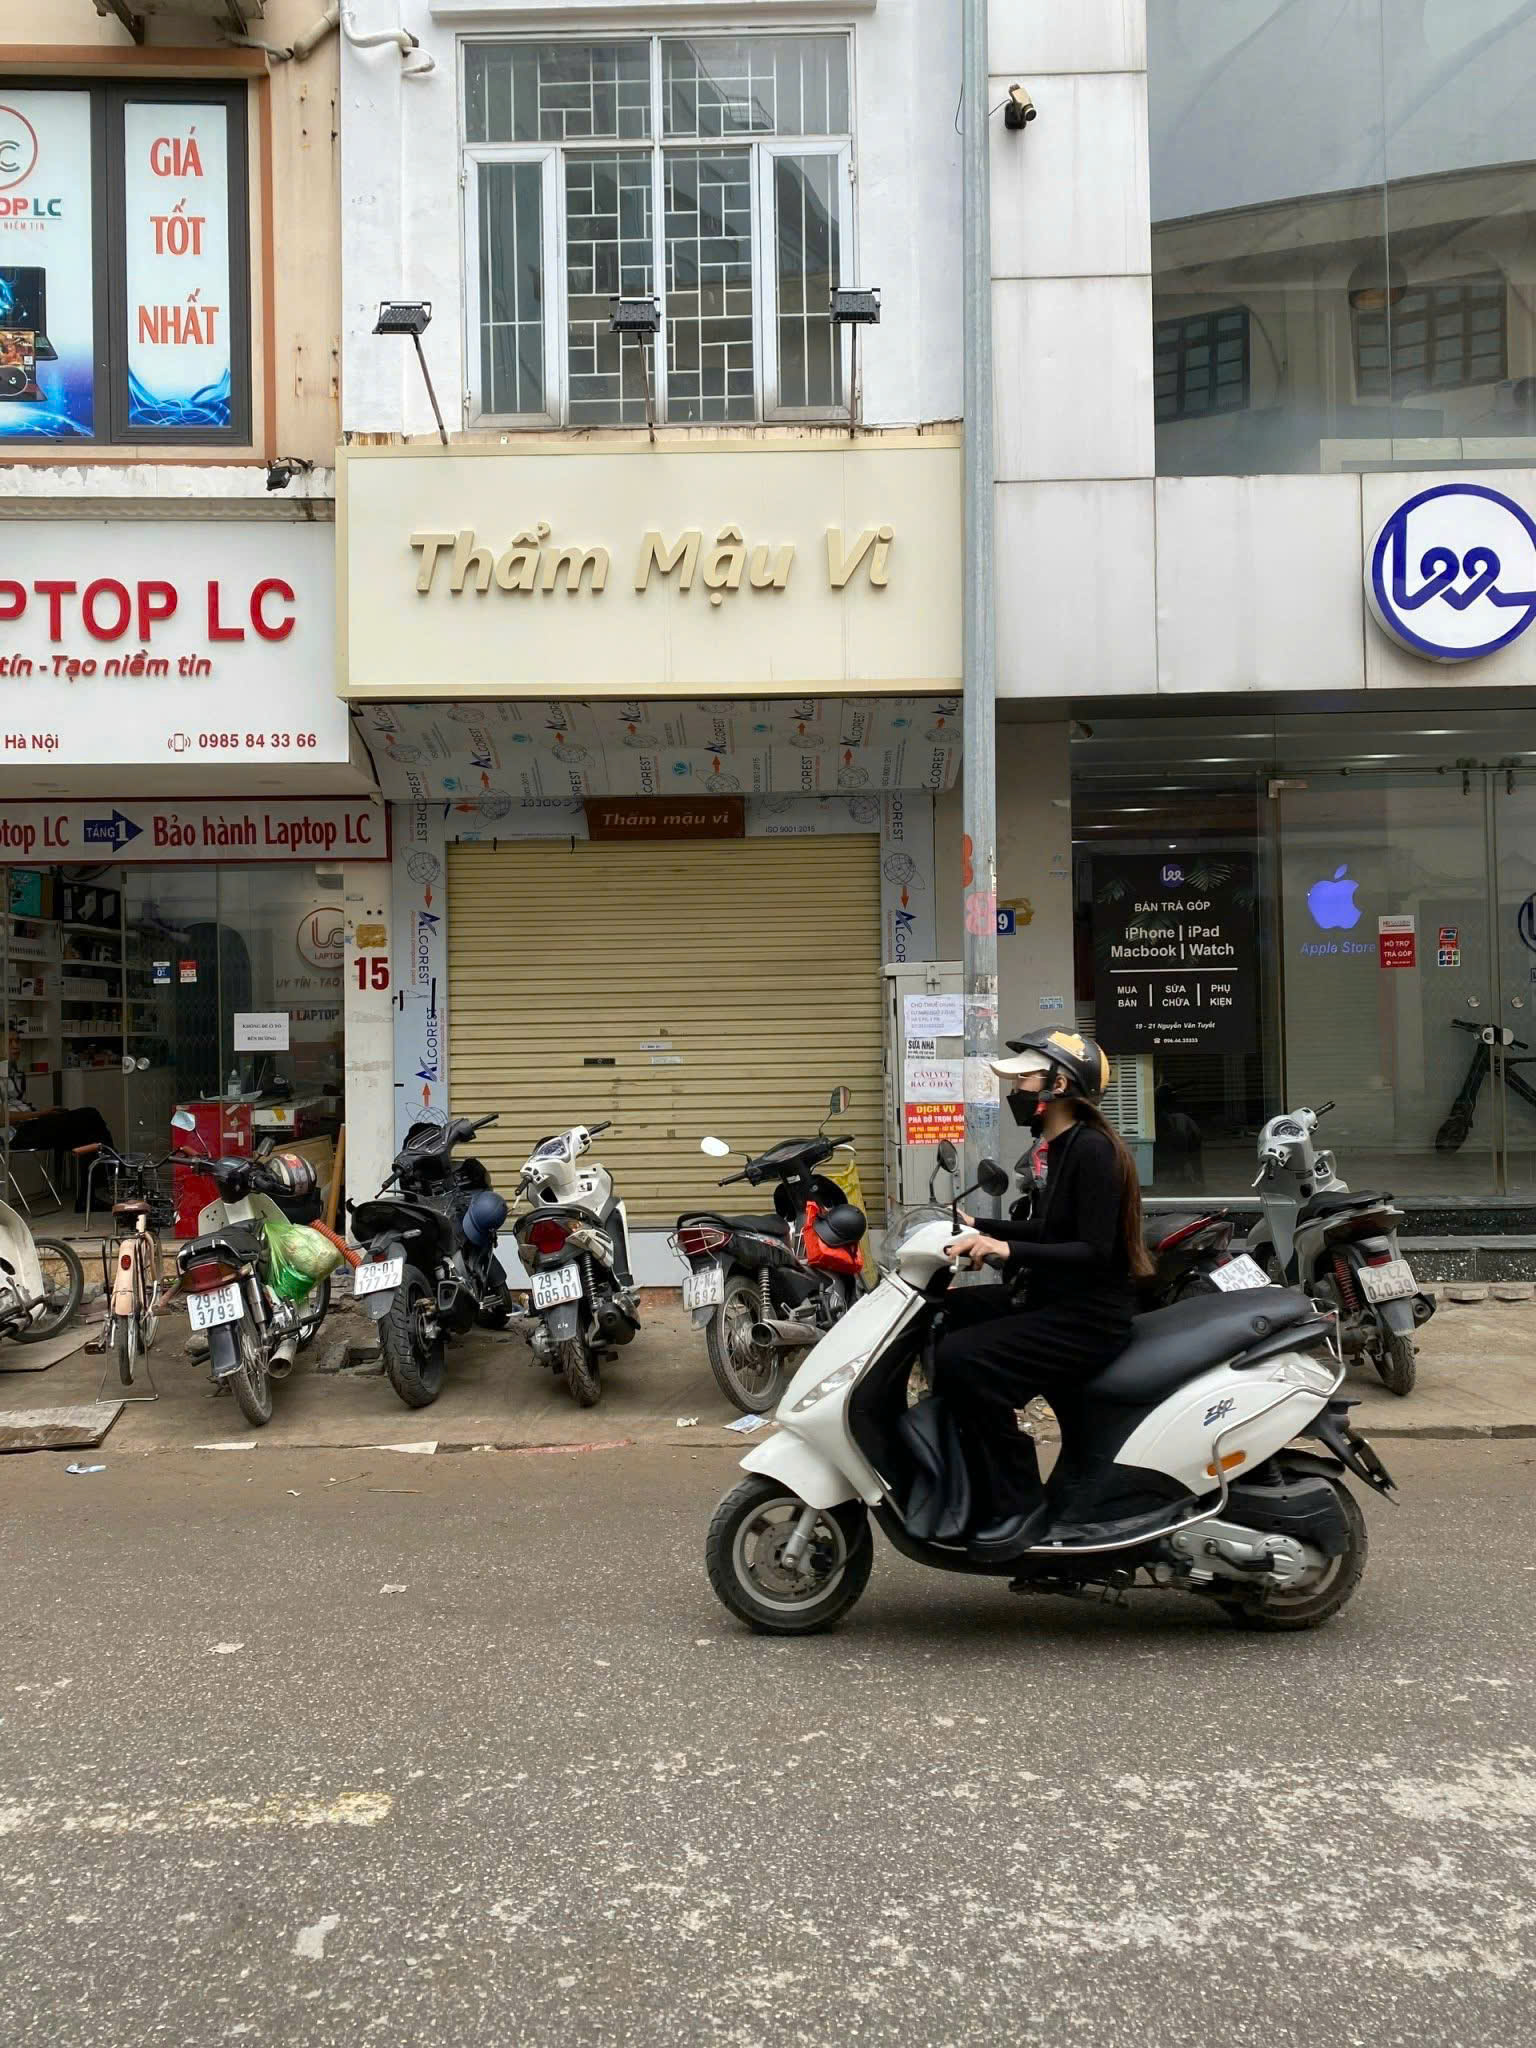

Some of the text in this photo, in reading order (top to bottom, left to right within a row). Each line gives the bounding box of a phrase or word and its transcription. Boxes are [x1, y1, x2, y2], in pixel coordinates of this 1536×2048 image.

[150, 126, 203, 177] GIÁ
[33, 198, 62, 216] LC
[150, 198, 205, 256] TỐT
[138, 288, 219, 345] NHẤT
[410, 521, 895, 606] Thẩm Mậu Vi
[207, 577, 296, 642] LC
[104, 649, 169, 677] niềm
[178, 655, 212, 677] tin
[5, 733, 59, 752] Hà Nội
[199, 732, 317, 748] 0985 84 33 66
[0, 819, 36, 854] top
[43, 815, 70, 847] LC
[115, 820, 129, 842] 1
[153, 814, 196, 847] Bảo
[203, 815, 257, 846] hành
[265, 814, 337, 851] Laptop
[344, 813, 372, 845] LC
[1186, 900, 1211, 911] GÓP
[1125, 925, 1220, 940] iPhone iPad
[418, 911, 440, 986] ALCOREST
[1111, 943, 1234, 958] Macbook Watch
[1301, 941, 1376, 956] Apple Store
[354, 957, 389, 990] 15
[1117, 985, 1138, 994] MUA
[916, 1105, 940, 1115] DỊCH
[534, 1268, 574, 1285] 29-Y3
[536, 1284, 581, 1308] 085.01
[198, 1303, 236, 1326] 3793
